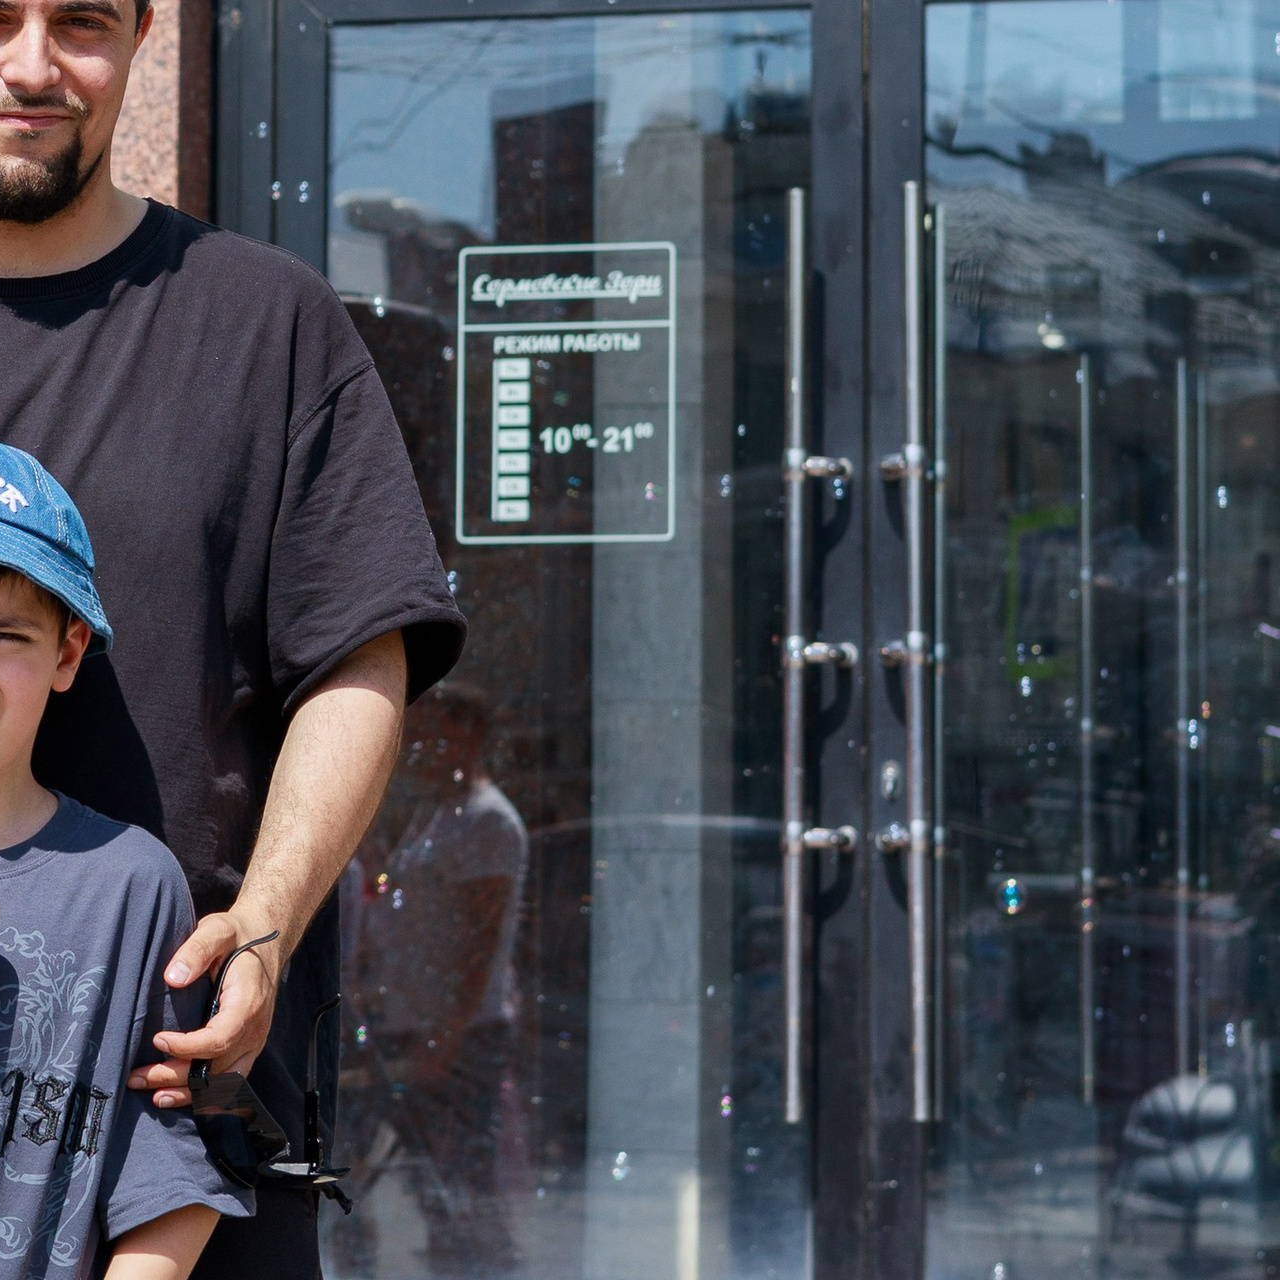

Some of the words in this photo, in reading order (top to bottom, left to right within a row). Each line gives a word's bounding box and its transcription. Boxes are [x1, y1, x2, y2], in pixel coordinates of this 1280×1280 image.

[604, 270, 663, 305] Зори
[493, 334, 560, 355] РЕЖИМ
[562, 332, 641, 352] РАБОТЫ
